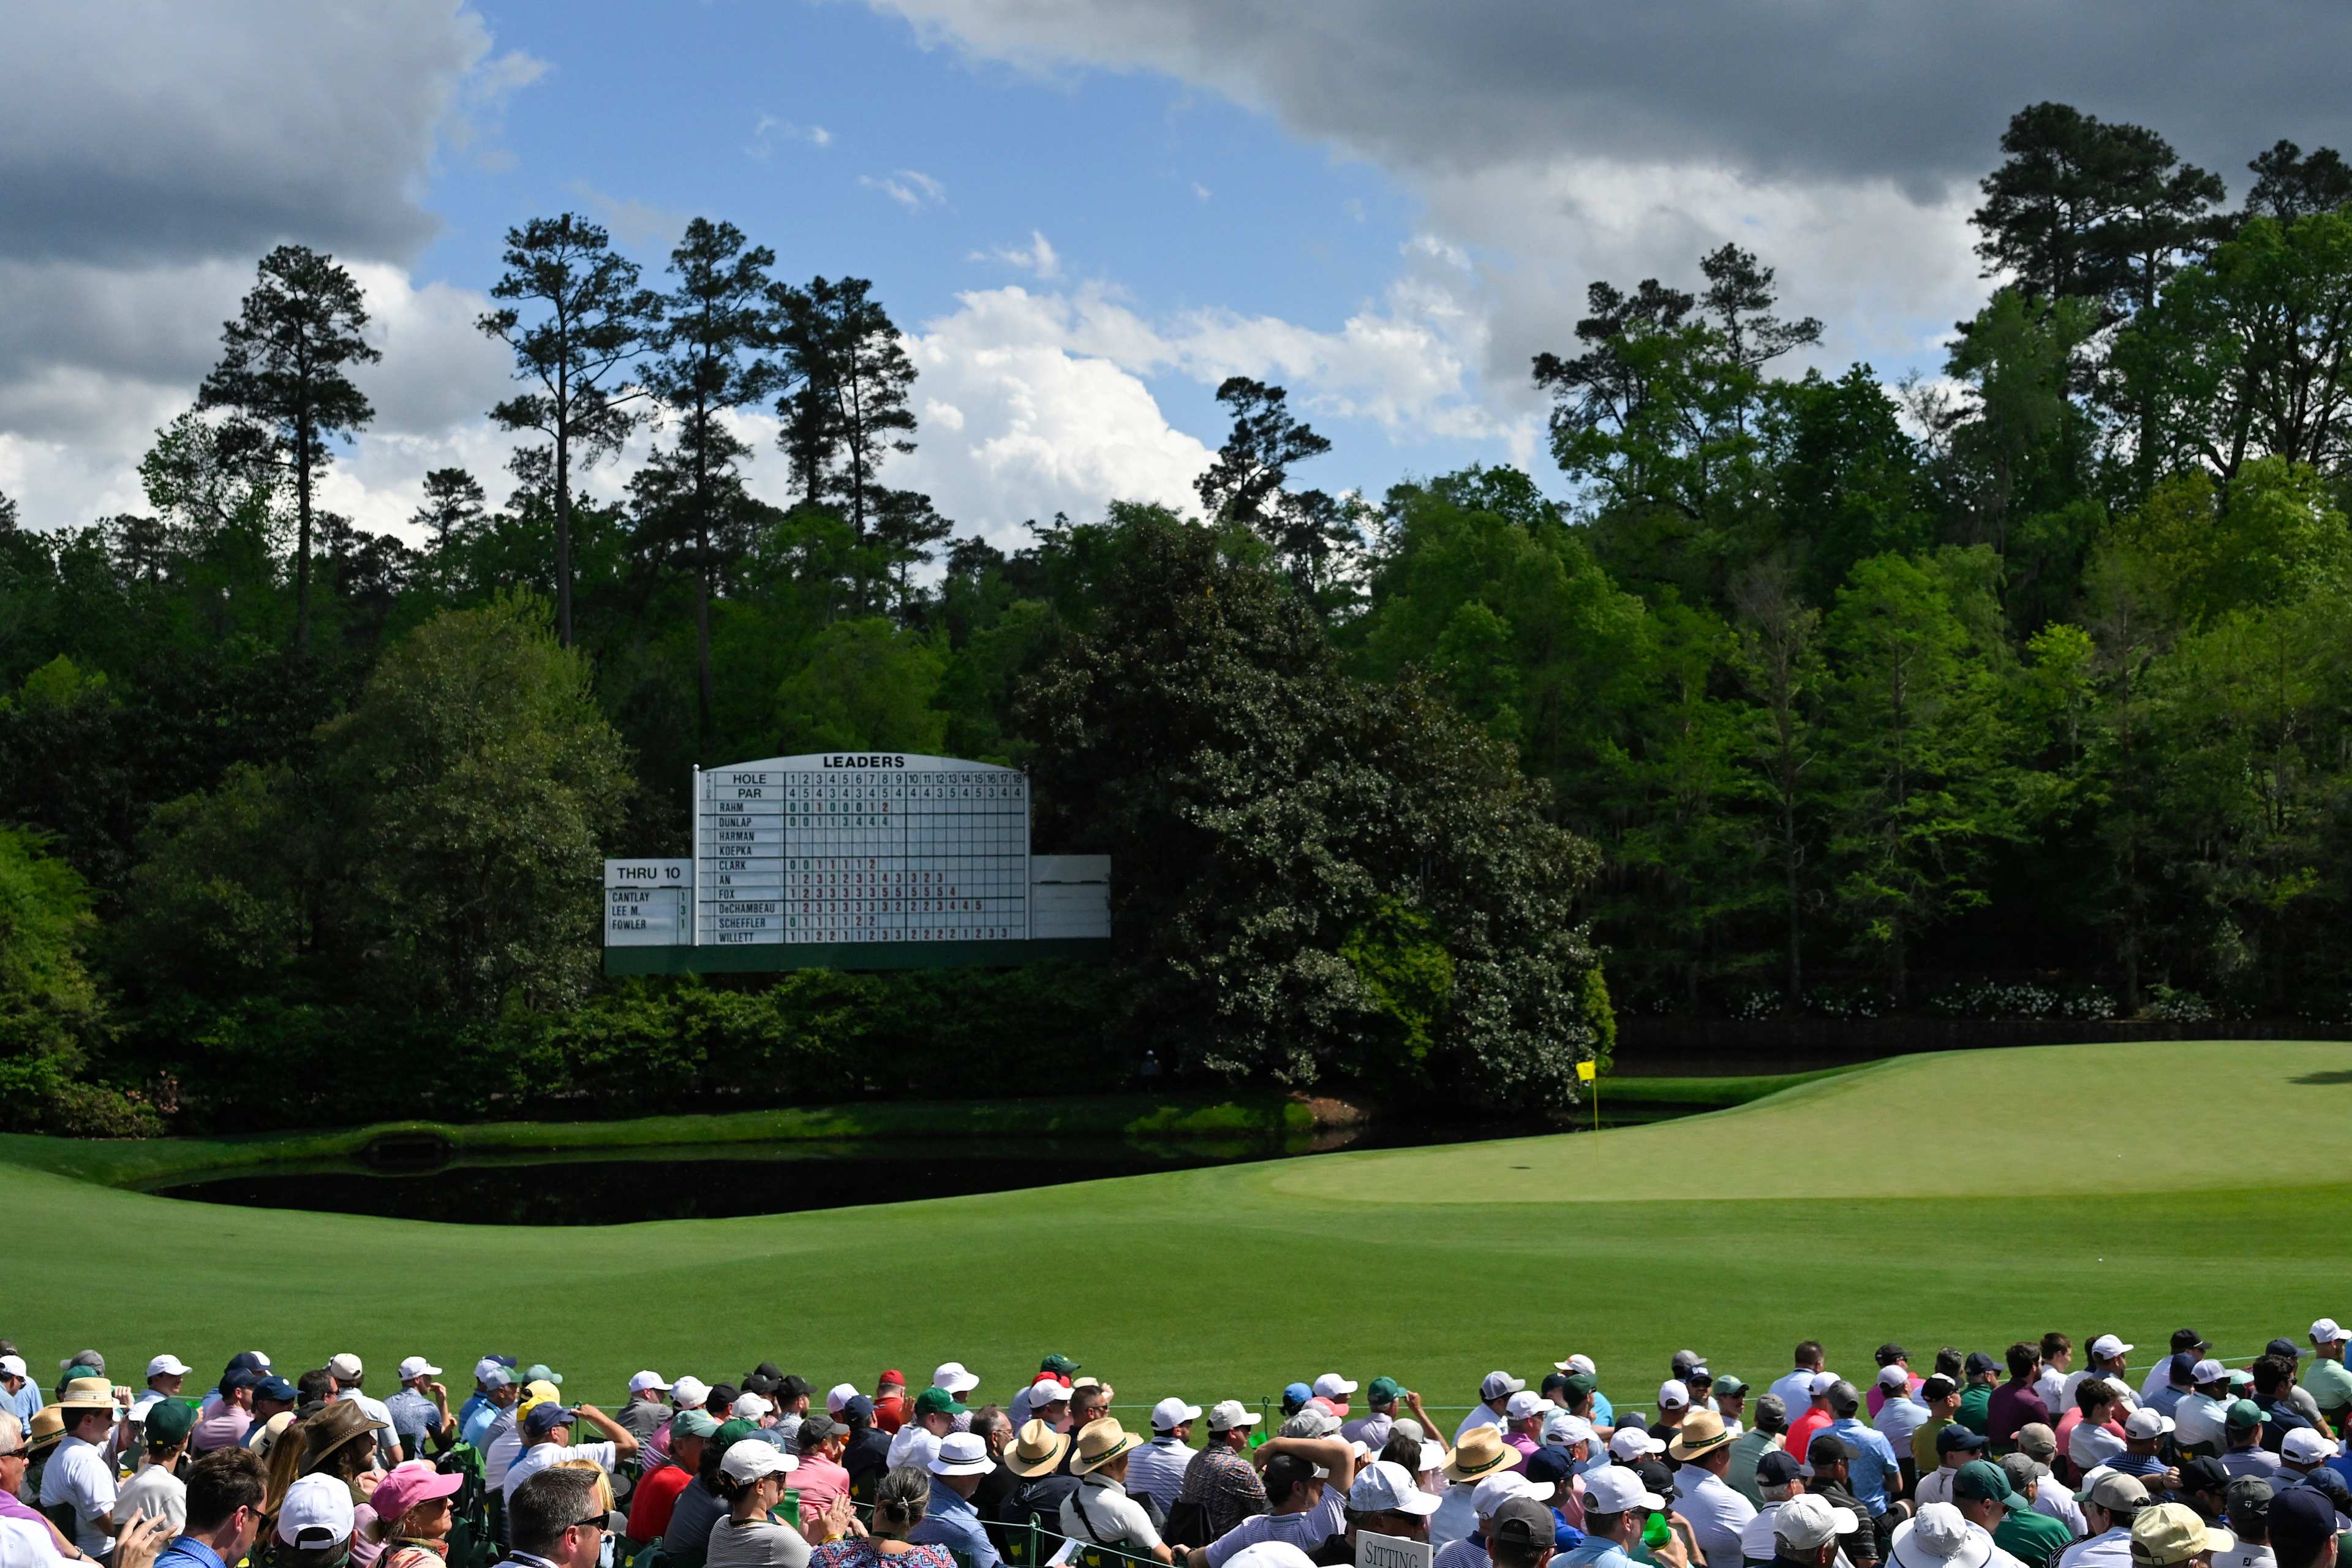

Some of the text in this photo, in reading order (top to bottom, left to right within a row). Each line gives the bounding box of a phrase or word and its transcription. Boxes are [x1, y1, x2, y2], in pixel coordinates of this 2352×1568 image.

[824, 756, 905, 767] LEADERS
[733, 774, 766, 784] HOLE
[791, 774, 795, 784] 1
[804, 774, 809, 784] 2
[816, 774, 822, 784] 3
[829, 775, 835, 783] 4
[843, 774, 848, 785] 5
[856, 774, 862, 784] 6
[870, 774, 875, 784] 7
[882, 774, 888, 784] 8
[896, 774, 902, 784] 9
[909, 774, 918, 784] 10
[936, 774, 944, 784] 12
[949, 774, 957, 783] 13
[962, 774, 970, 783] 14
[974, 774, 983, 783] 15
[987, 774, 996, 783] 16
[1001, 774, 1008, 783] 17
[1013, 774, 1022, 783] 18
[738, 788, 761, 798] PAR
[790, 789, 795, 797] 4
[804, 788, 809, 798] 5
[816, 789, 822, 797] 4
[830, 788, 835, 798] 3
[843, 789, 848, 797] 4
[856, 789, 862, 798] 3
[870, 789, 875, 797] 4
[883, 788, 888, 797] 5
[924, 789, 930, 797] 4
[937, 788, 943, 797] 3
[951, 788, 956, 797] 5
[963, 788, 968, 797] 4
[976, 788, 981, 797] 5
[989, 788, 995, 797] 3
[1002, 788, 1007, 796] 4
[1014, 788, 1020, 797] 4
[720, 802, 888, 812] RAHM 0 0 1 0 0 0 1 2
[719, 816, 888, 827] DUNLAP 0 0 1 1 3 4 4 4
[719, 831, 755, 841] HARMAN
[719, 846, 752, 856] KOEPKA
[719, 859, 875, 870] CLARK 0 0 1 1 1 1 2
[617, 867, 680, 879] THRU 10
[719, 873, 942, 884] AN 1 2 3 3 2 3 3 4 3 3 2 3
[612, 892, 685, 902] CANTLAY 1
[719, 887, 955, 899] FOX 1 2 3 3 3 3 3 5 5 5 5 5 4
[612, 905, 686, 916] LEE M. 3
[719, 900, 981, 913] DeCHAMBEAU 1 2 3 3 3 3 3 3 2 2 2 3 4 4 5
[612, 919, 646, 930] FOWLER
[719, 916, 875, 928] SCHEFFLER 0 1 1 1 1 2 2
[719, 927, 1007, 942] WILLETT 1 1 2 2 1 1 2 3 3 2 2 2 2 1 2 3 3
[1365, 1541, 1419, 1568] SITTING
[2243, 1558, 2252, 1567] FJ
